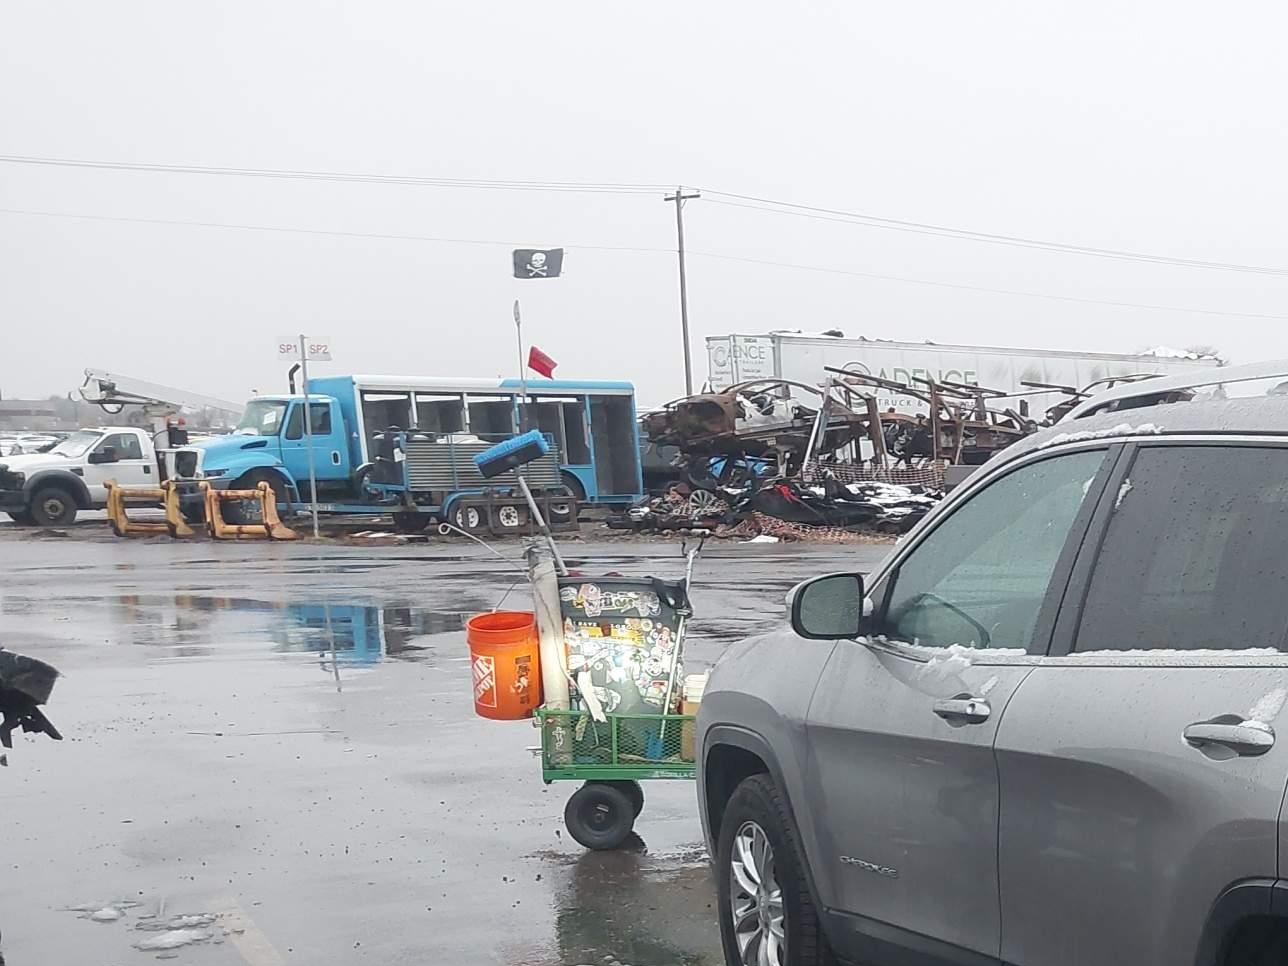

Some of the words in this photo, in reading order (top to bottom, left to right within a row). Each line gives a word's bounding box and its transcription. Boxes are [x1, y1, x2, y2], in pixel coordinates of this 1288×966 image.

[279, 344, 298, 353] SP1
[310, 344, 329, 354] SP2
[877, 399, 912, 407] TRUCK
